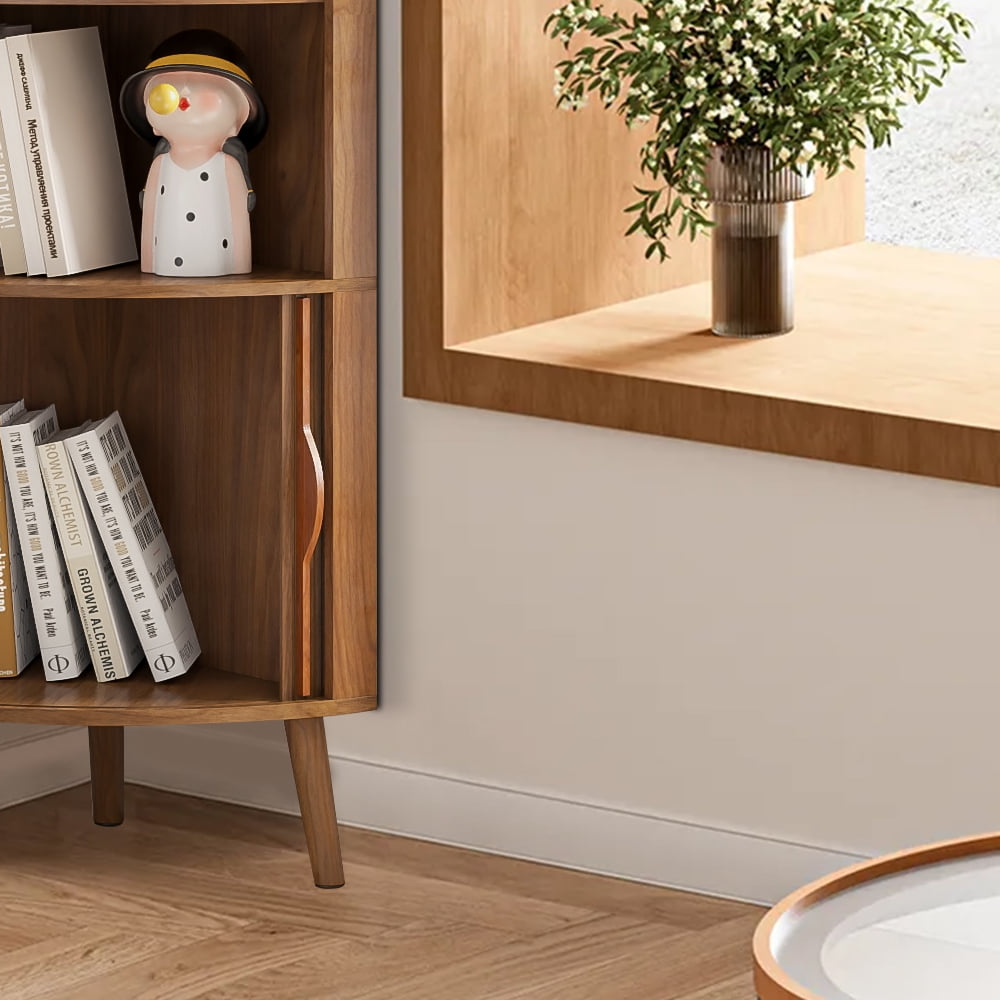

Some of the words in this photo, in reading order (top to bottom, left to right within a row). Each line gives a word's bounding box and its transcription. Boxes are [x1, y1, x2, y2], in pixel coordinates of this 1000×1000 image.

[27, 118, 40, 148] Метод
[40, 208, 59, 259] проектами
[55, 483, 83, 547] ALCHEMIST
[42, 607, 55, 620] Paul
[139, 608, 151, 624] Paul
[45, 622, 57, 638] Arden
[77, 568, 99, 614] GROWN
[90, 618, 117, 681] ALCHEMIS
[143, 622, 158, 639] Arden
